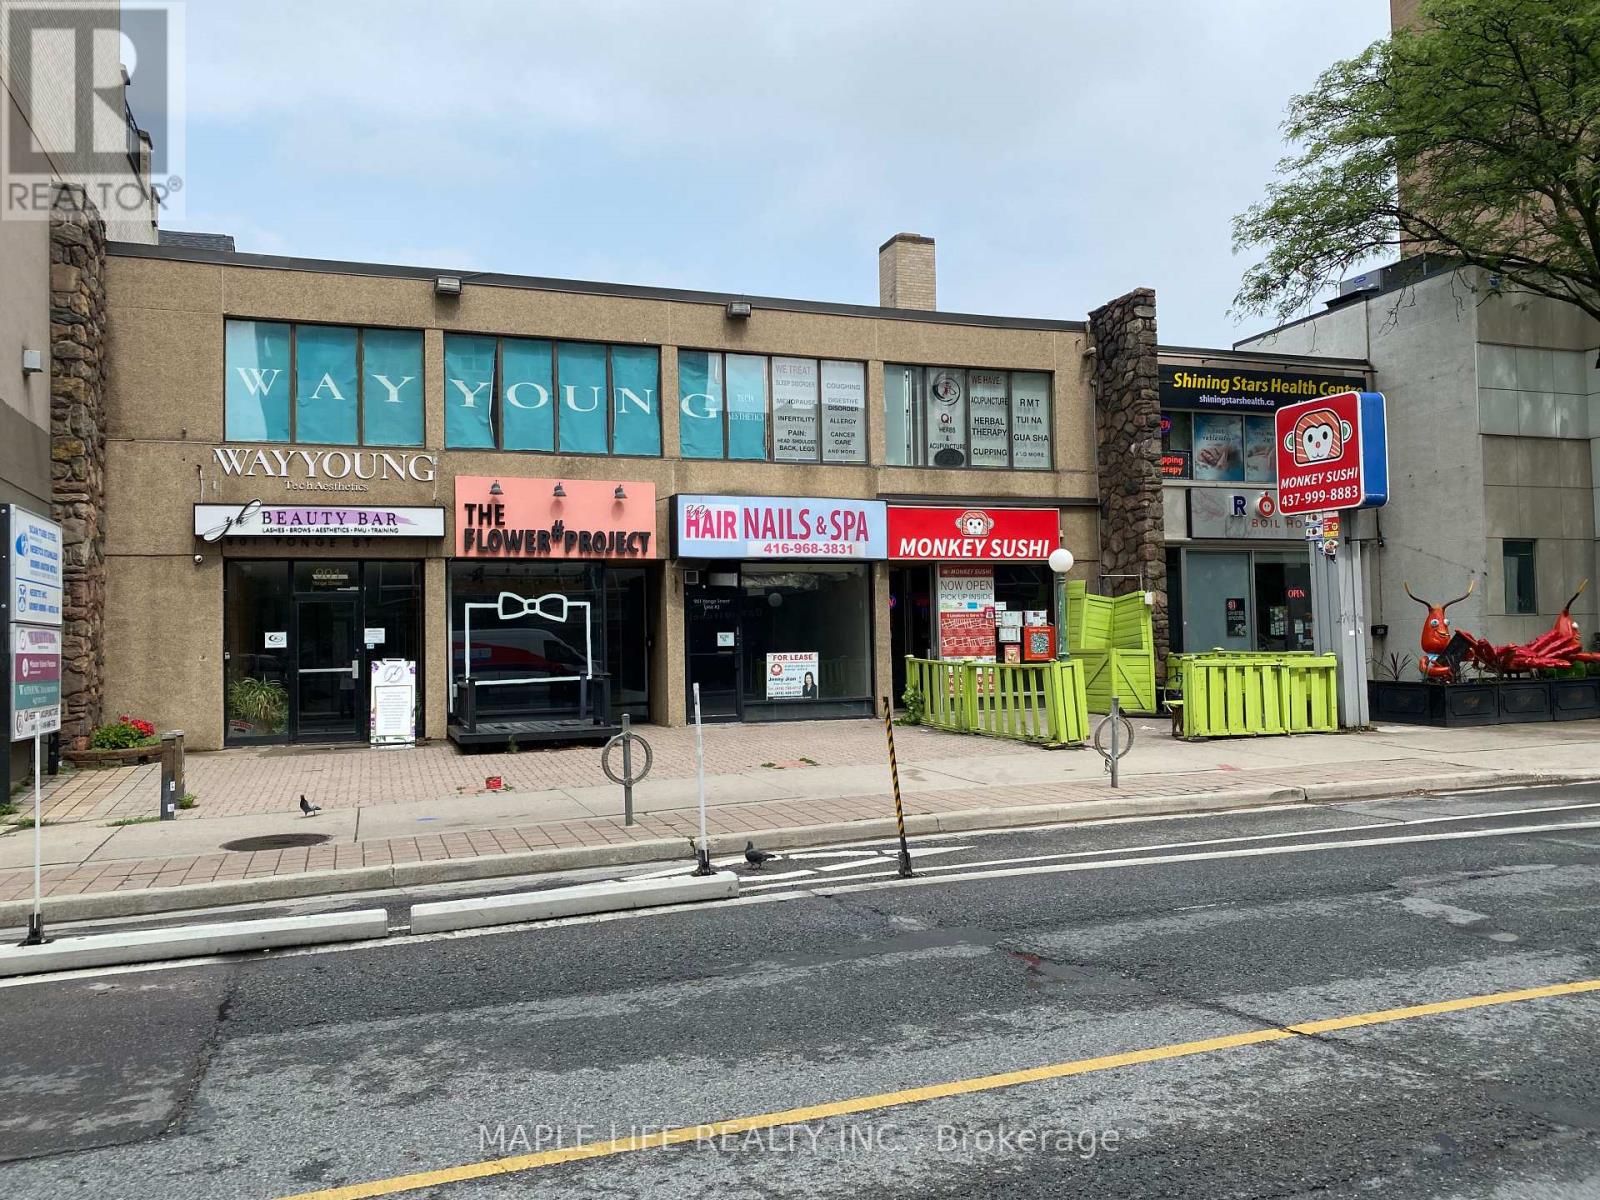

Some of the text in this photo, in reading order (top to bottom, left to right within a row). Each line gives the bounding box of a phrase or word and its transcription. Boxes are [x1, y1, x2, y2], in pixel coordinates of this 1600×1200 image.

[972, 375, 983, 384] WE
[1173, 371, 1230, 394] Shining
[1232, 376, 1269, 393] Stars
[1271, 378, 1316, 395] Health
[826, 382, 861, 391] COUGHING
[971, 396, 1009, 406] ACUPUNCTURE
[1199, 394, 1275, 406] shiningstarshealth.ca
[777, 415, 815, 423] INFERTILITY
[974, 416, 1005, 426] HERBAL
[1016, 416, 1042, 424] TUI NA
[787, 429, 807, 437] PAIN:
[972, 427, 1008, 437] THERAPY
[1032, 434, 1049, 442] SHA
[973, 448, 1008, 456] CUPPING
[1280, 467, 1358, 490] MONKEY SUSHI
[1281, 485, 1358, 507] 437-999-8883
[261, 511, 398, 526] BEAUTY BAR
[464, 503, 506, 526] THE
[686, 508, 869, 542] HAIR NAILS & SPA
[1251, 519, 1305, 529] BOIL HO
[464, 528, 551, 553] FLOWER
[564, 531, 651, 554] PROJECT
[763, 543, 853, 555] 416-968-3831
[899, 538, 1050, 558] MONKEY SUSHI
[940, 580, 993, 590] NOW OPEN
[1287, 589, 1305, 598] OPEN
[790, 653, 813, 661] LEASE
